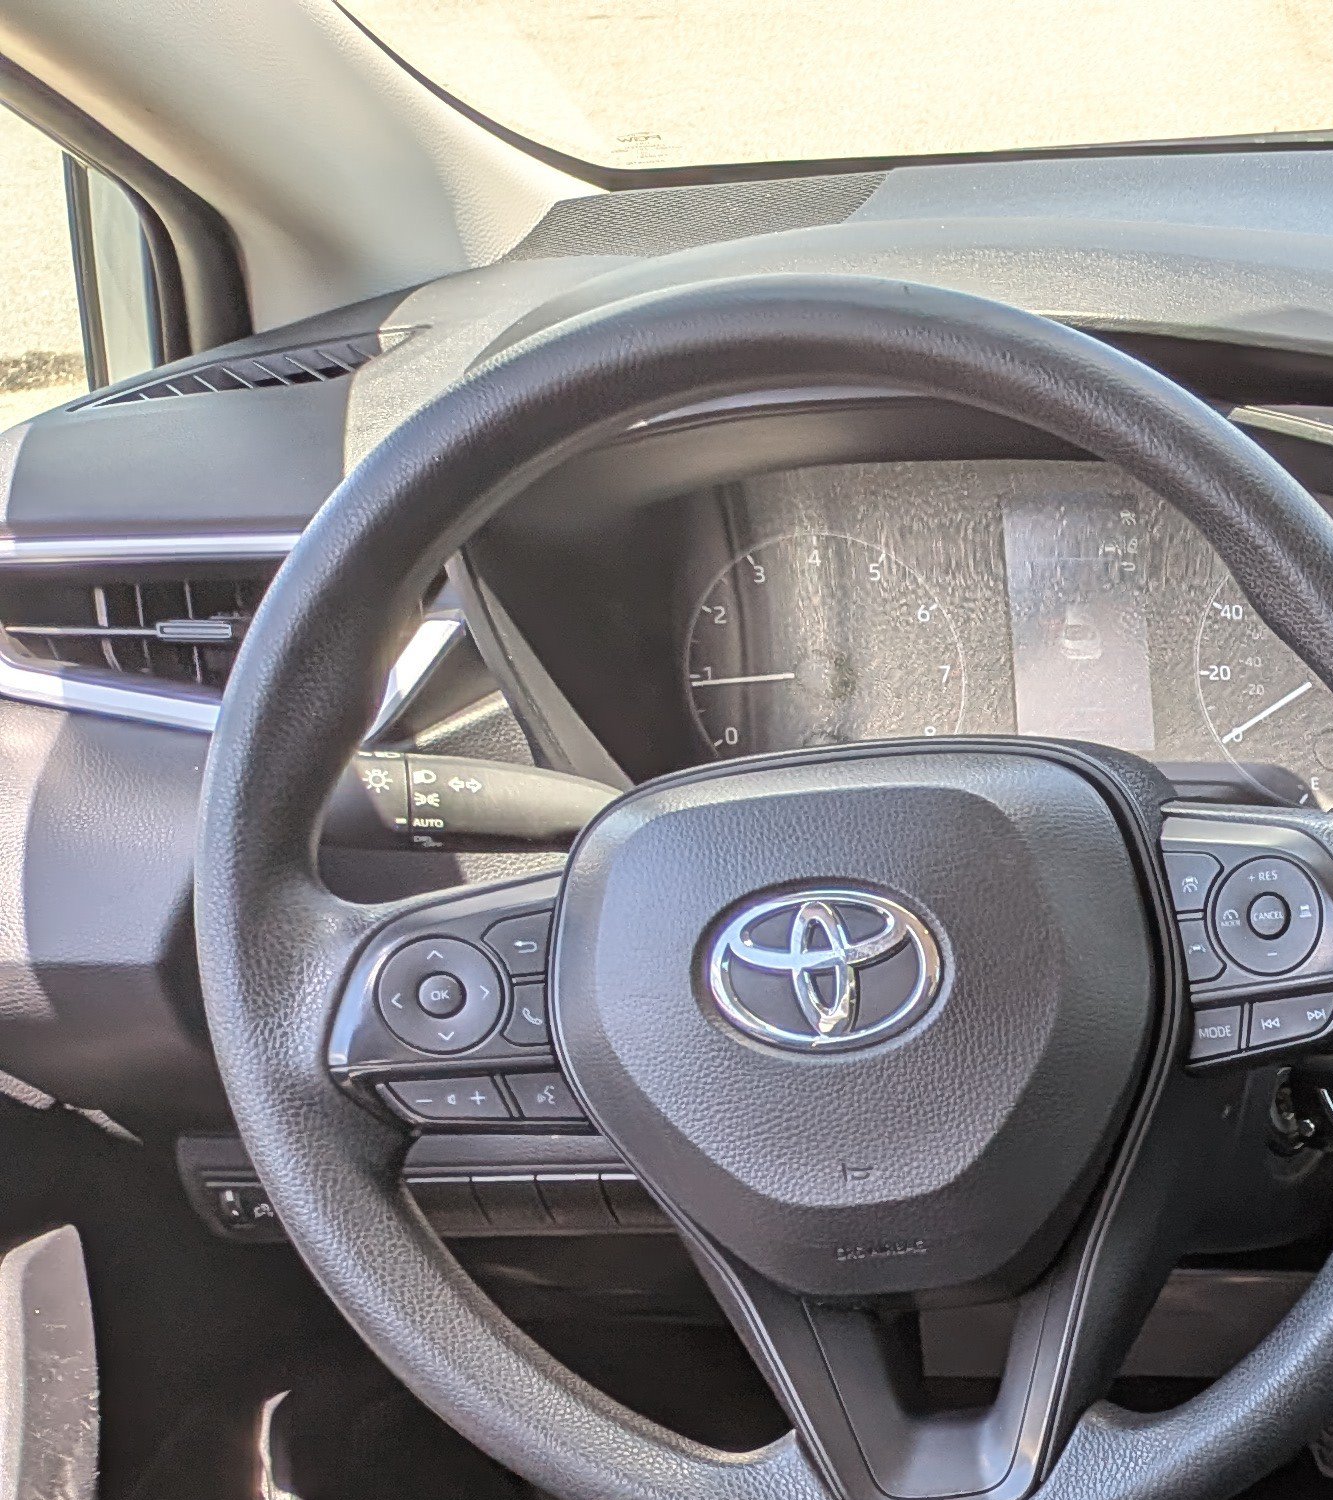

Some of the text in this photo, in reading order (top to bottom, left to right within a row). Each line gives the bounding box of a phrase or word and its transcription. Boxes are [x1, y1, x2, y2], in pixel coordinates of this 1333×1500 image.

[808, 550, 821, 567] 4
[753, 565, 766, 584] 3
[869, 564, 881, 581] 5
[714, 606, 727, 624] 2
[917, 605, 931, 622] 6
[1220, 604, 1243, 620] 40
[938, 666, 951, 683] 7
[1209, 665, 1231, 681] 20
[725, 726, 739, 745] 0
[1311, 776, 1320, 791] E
[413, 817, 445, 828] AUTO
[1258, 870, 1278, 881] RES
[1253, 911, 1284, 922] CANCEL
[430, 989, 450, 1001] OK
[1199, 1025, 1232, 1039] MODE
